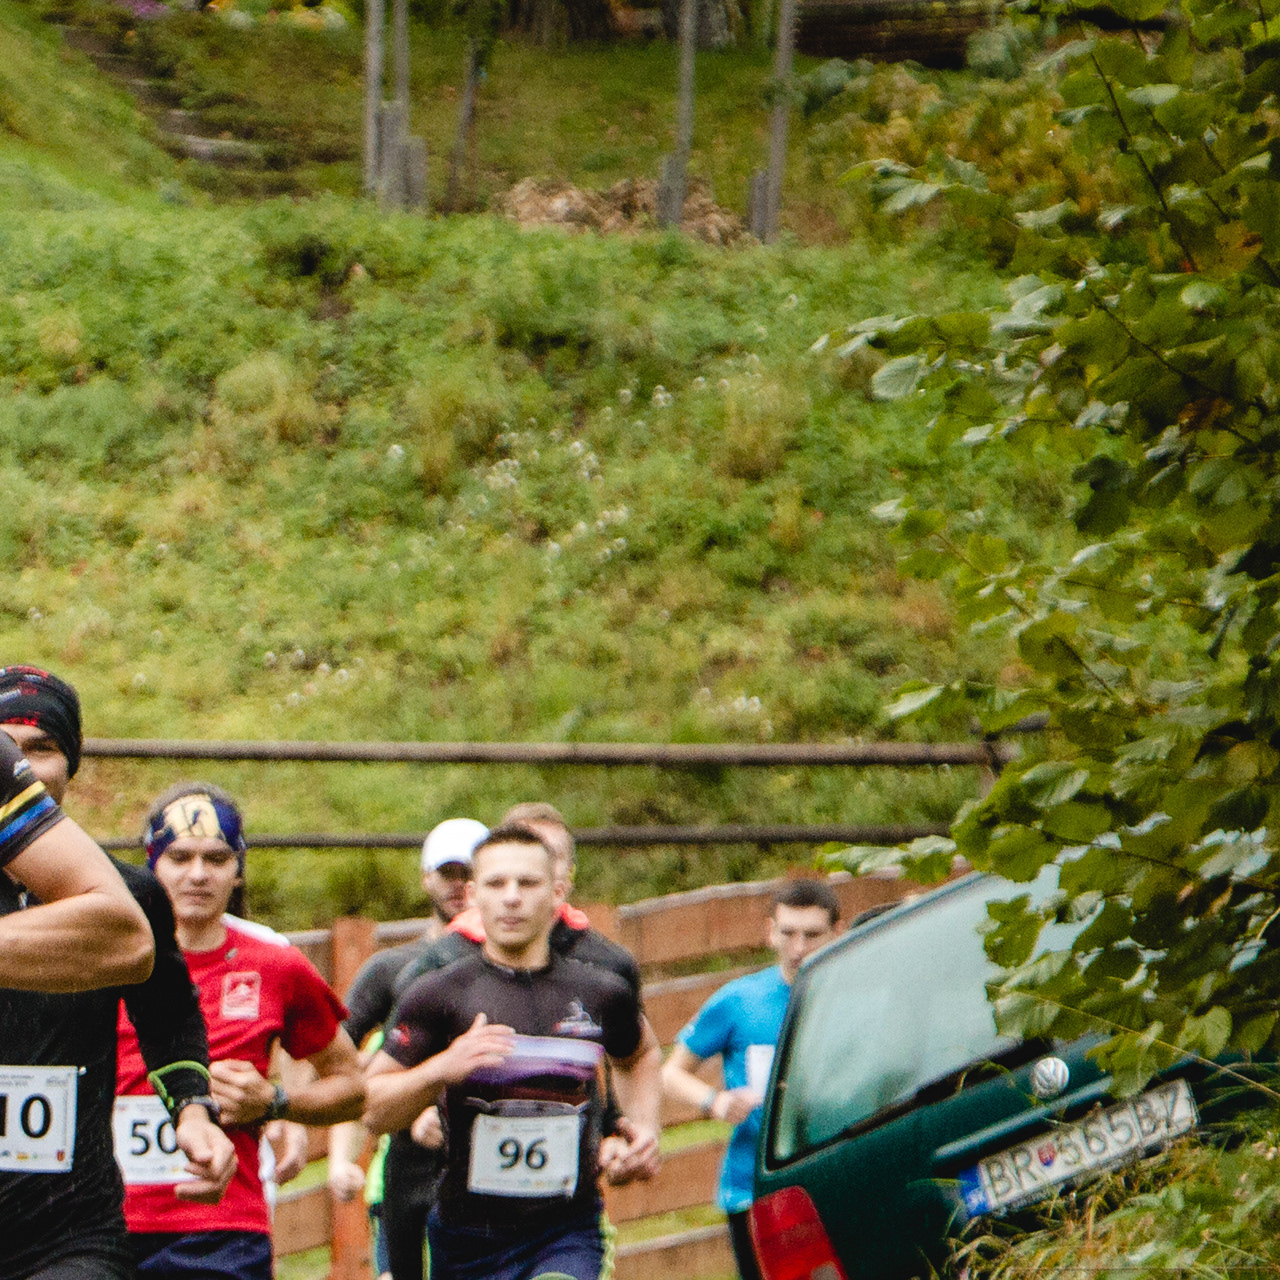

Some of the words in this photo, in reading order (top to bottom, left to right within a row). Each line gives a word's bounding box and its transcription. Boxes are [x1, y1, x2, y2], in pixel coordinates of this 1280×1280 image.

[130, 1119, 178, 1156] 50
[498, 1136, 549, 1171] 96
[985, 1146, 1038, 1199] BR
